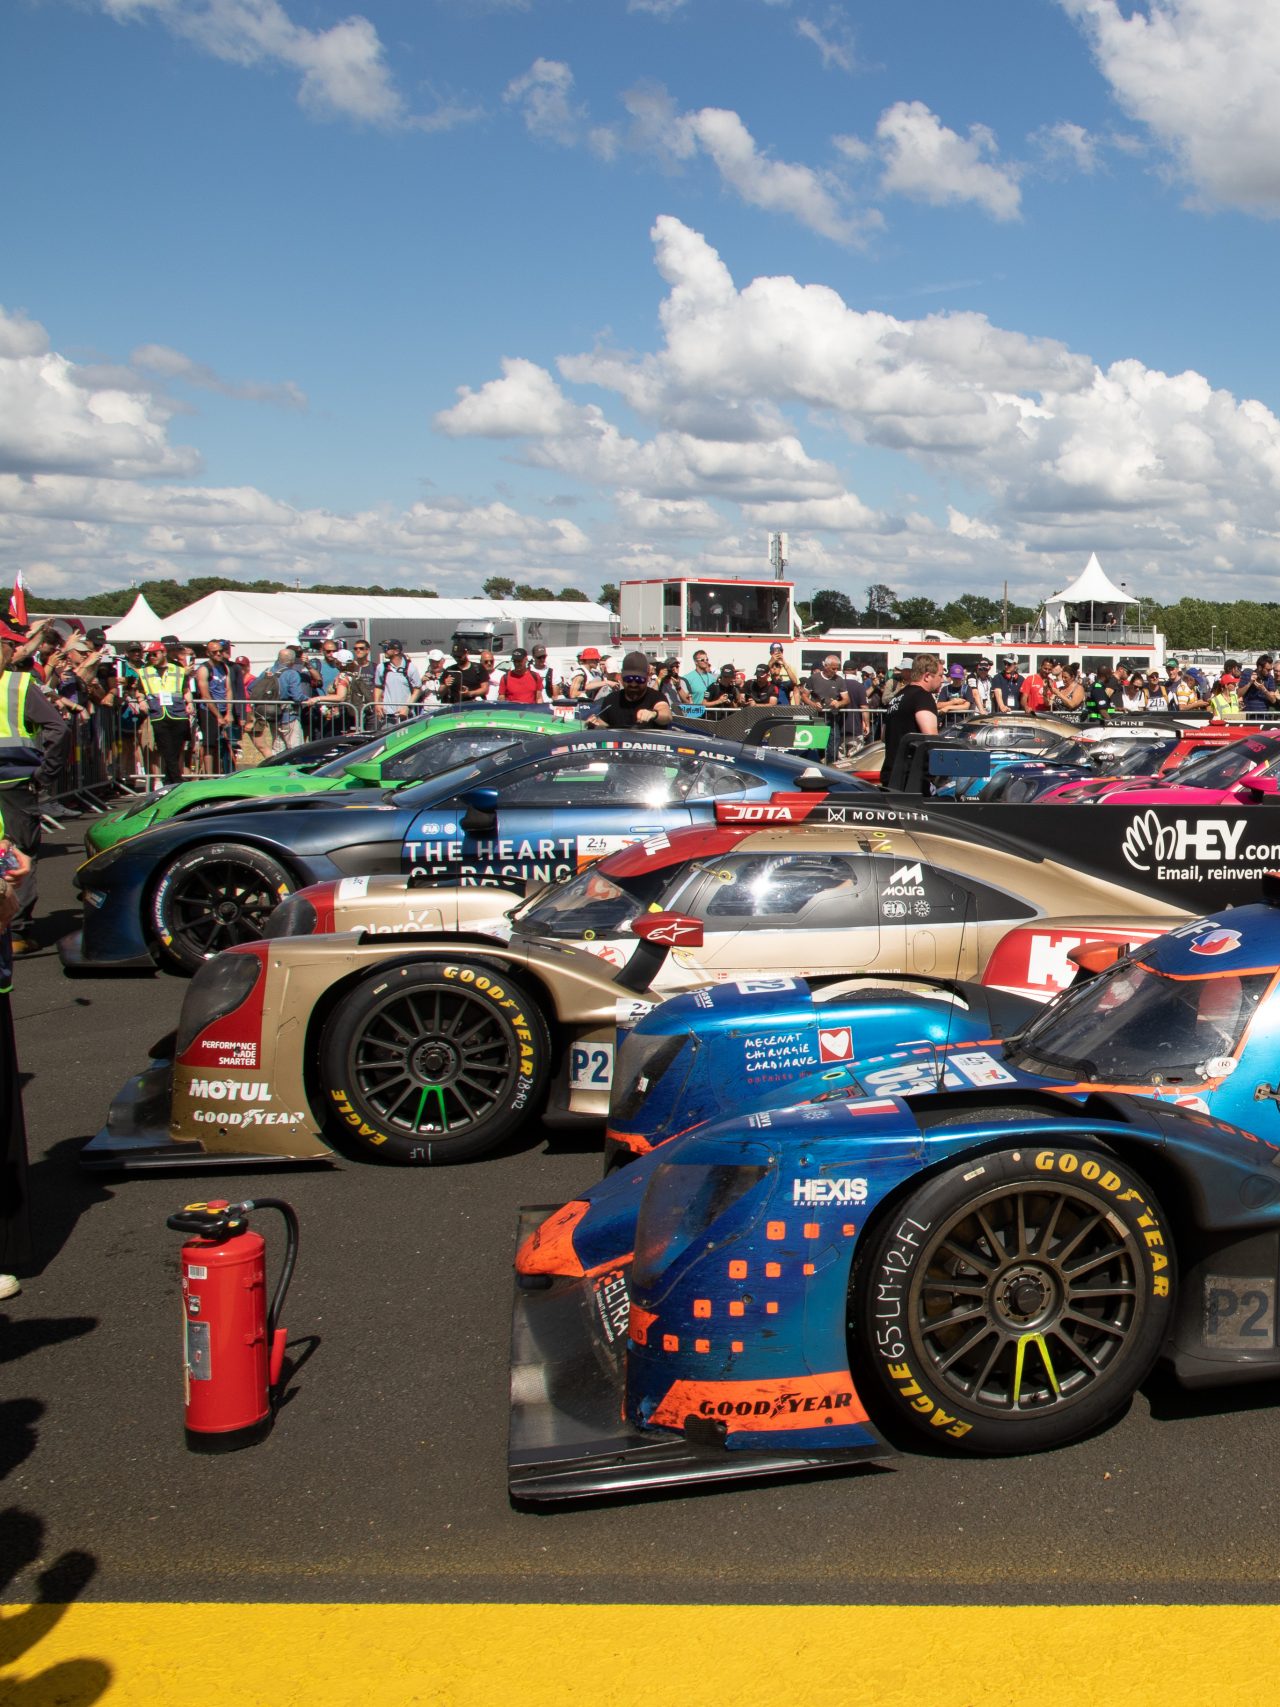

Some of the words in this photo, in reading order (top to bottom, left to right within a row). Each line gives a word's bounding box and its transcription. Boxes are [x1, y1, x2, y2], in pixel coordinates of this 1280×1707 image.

[571, 742, 597, 751] IAN
[622, 743, 674, 753] DANIEL
[697, 751, 736, 763] ALEX
[725, 807, 793, 820] JOTA
[852, 811, 929, 821] MONOLITH
[406, 841, 463, 862] THE
[477, 839, 575, 861] HEART
[1157, 866, 1203, 882] Email,
[155, 879, 170, 929] MICHELIN
[443, 966, 535, 1076] GOODYEAR
[201, 1041, 257, 1051] PERFORMANCE
[233, 1050, 257, 1058] MADE
[218, 1057, 256, 1066] SMARTER
[572, 1049, 610, 1083] P2
[189, 1079, 272, 1101] MOTUL
[193, 1109, 305, 1129] GOODYEAR
[331, 1089, 389, 1147] EAGLE
[793, 1178, 869, 1201] HEXIS
[1035, 1151, 1170, 1298] GOODYEAR
[876, 1218, 931, 1359] 65-LM-12-FL
[1208, 1287, 1269, 1337] P2
[700, 1392, 853, 1420] GOODYEAR
[888, 1362, 974, 1438] EAGLE
